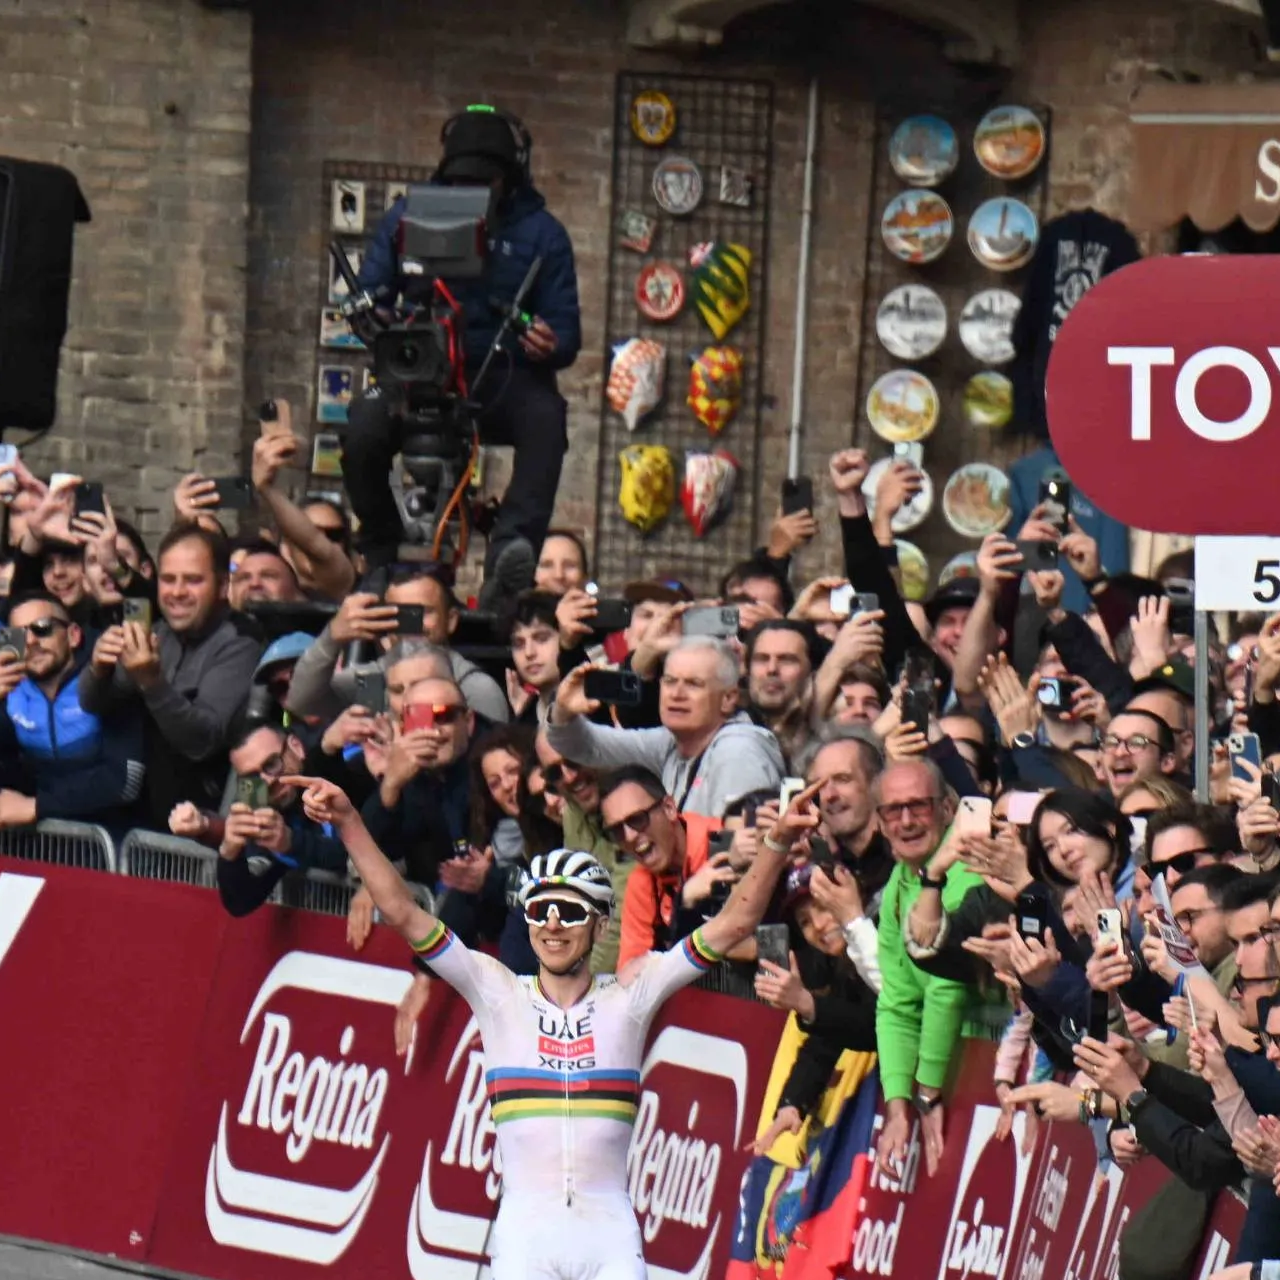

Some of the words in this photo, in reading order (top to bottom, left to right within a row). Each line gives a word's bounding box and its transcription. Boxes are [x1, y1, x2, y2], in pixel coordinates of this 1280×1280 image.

[538, 1015, 593, 1040] UAE
[538, 1055, 596, 1071] XRG
[237, 1011, 389, 1163] Regina
[627, 1090, 721, 1243] Regina
[851, 1200, 905, 1277] ood
